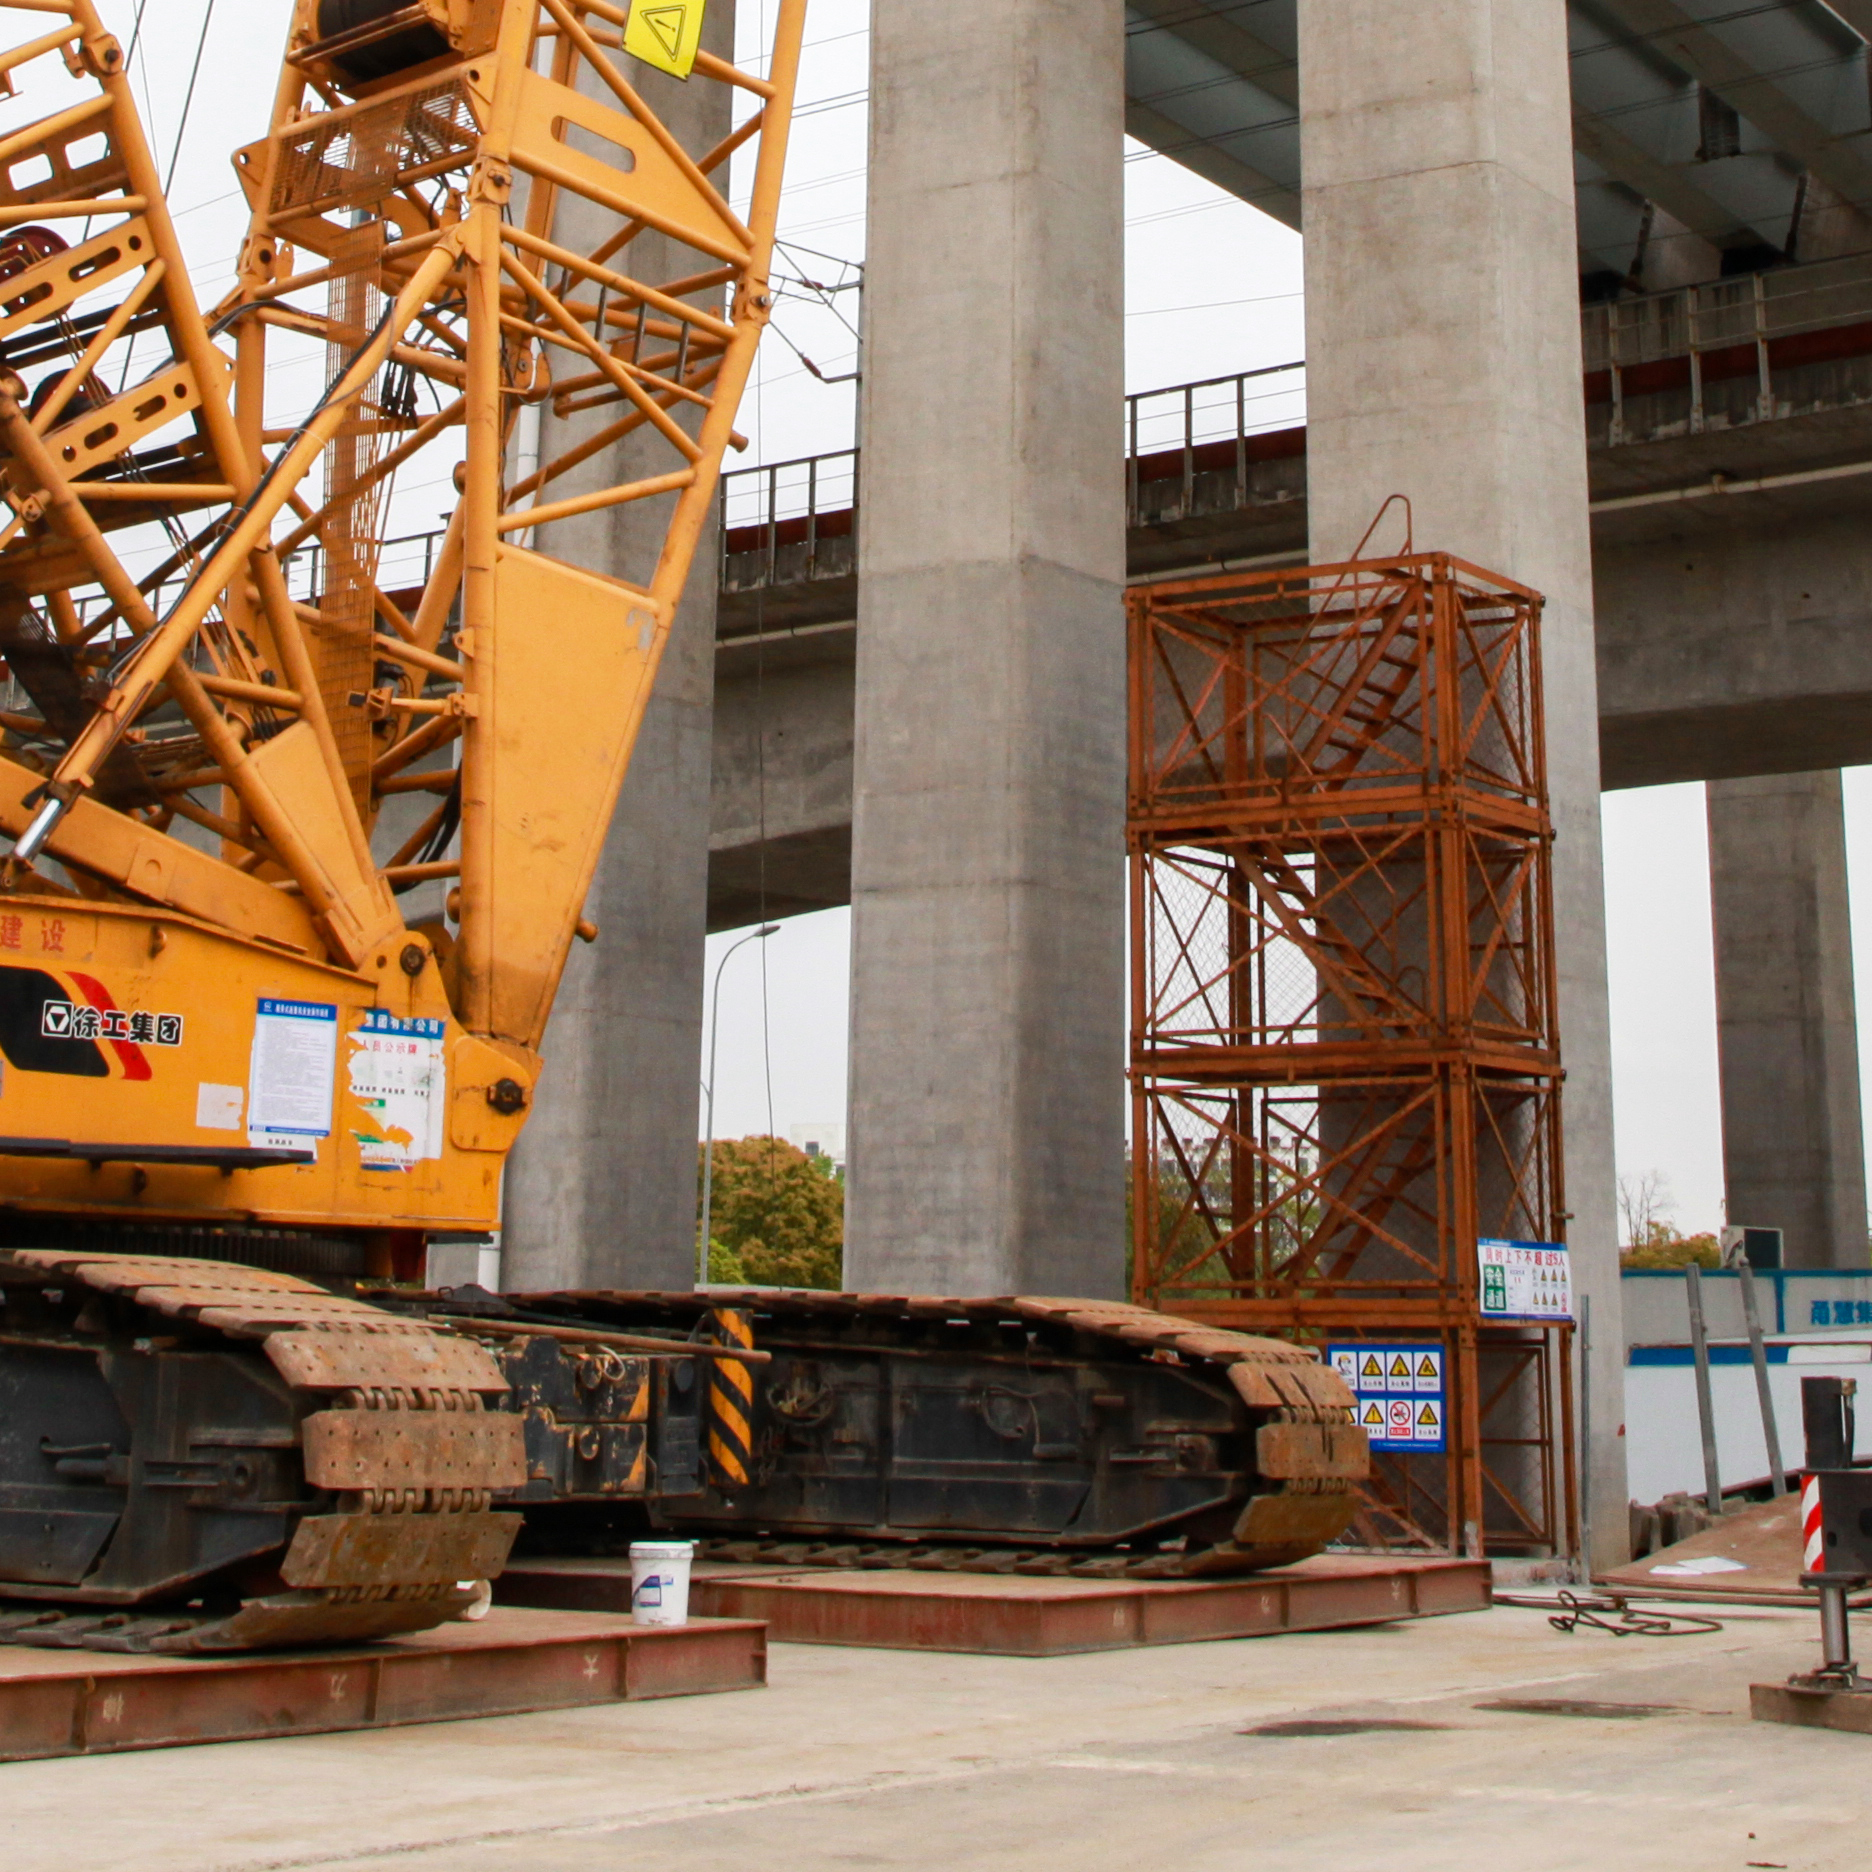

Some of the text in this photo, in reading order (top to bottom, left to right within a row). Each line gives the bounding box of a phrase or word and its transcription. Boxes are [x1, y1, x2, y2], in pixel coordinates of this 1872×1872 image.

[73, 1006, 184, 1046] 徐工集团
[1485, 1248, 1565, 1266] 同时上下不超过5人
